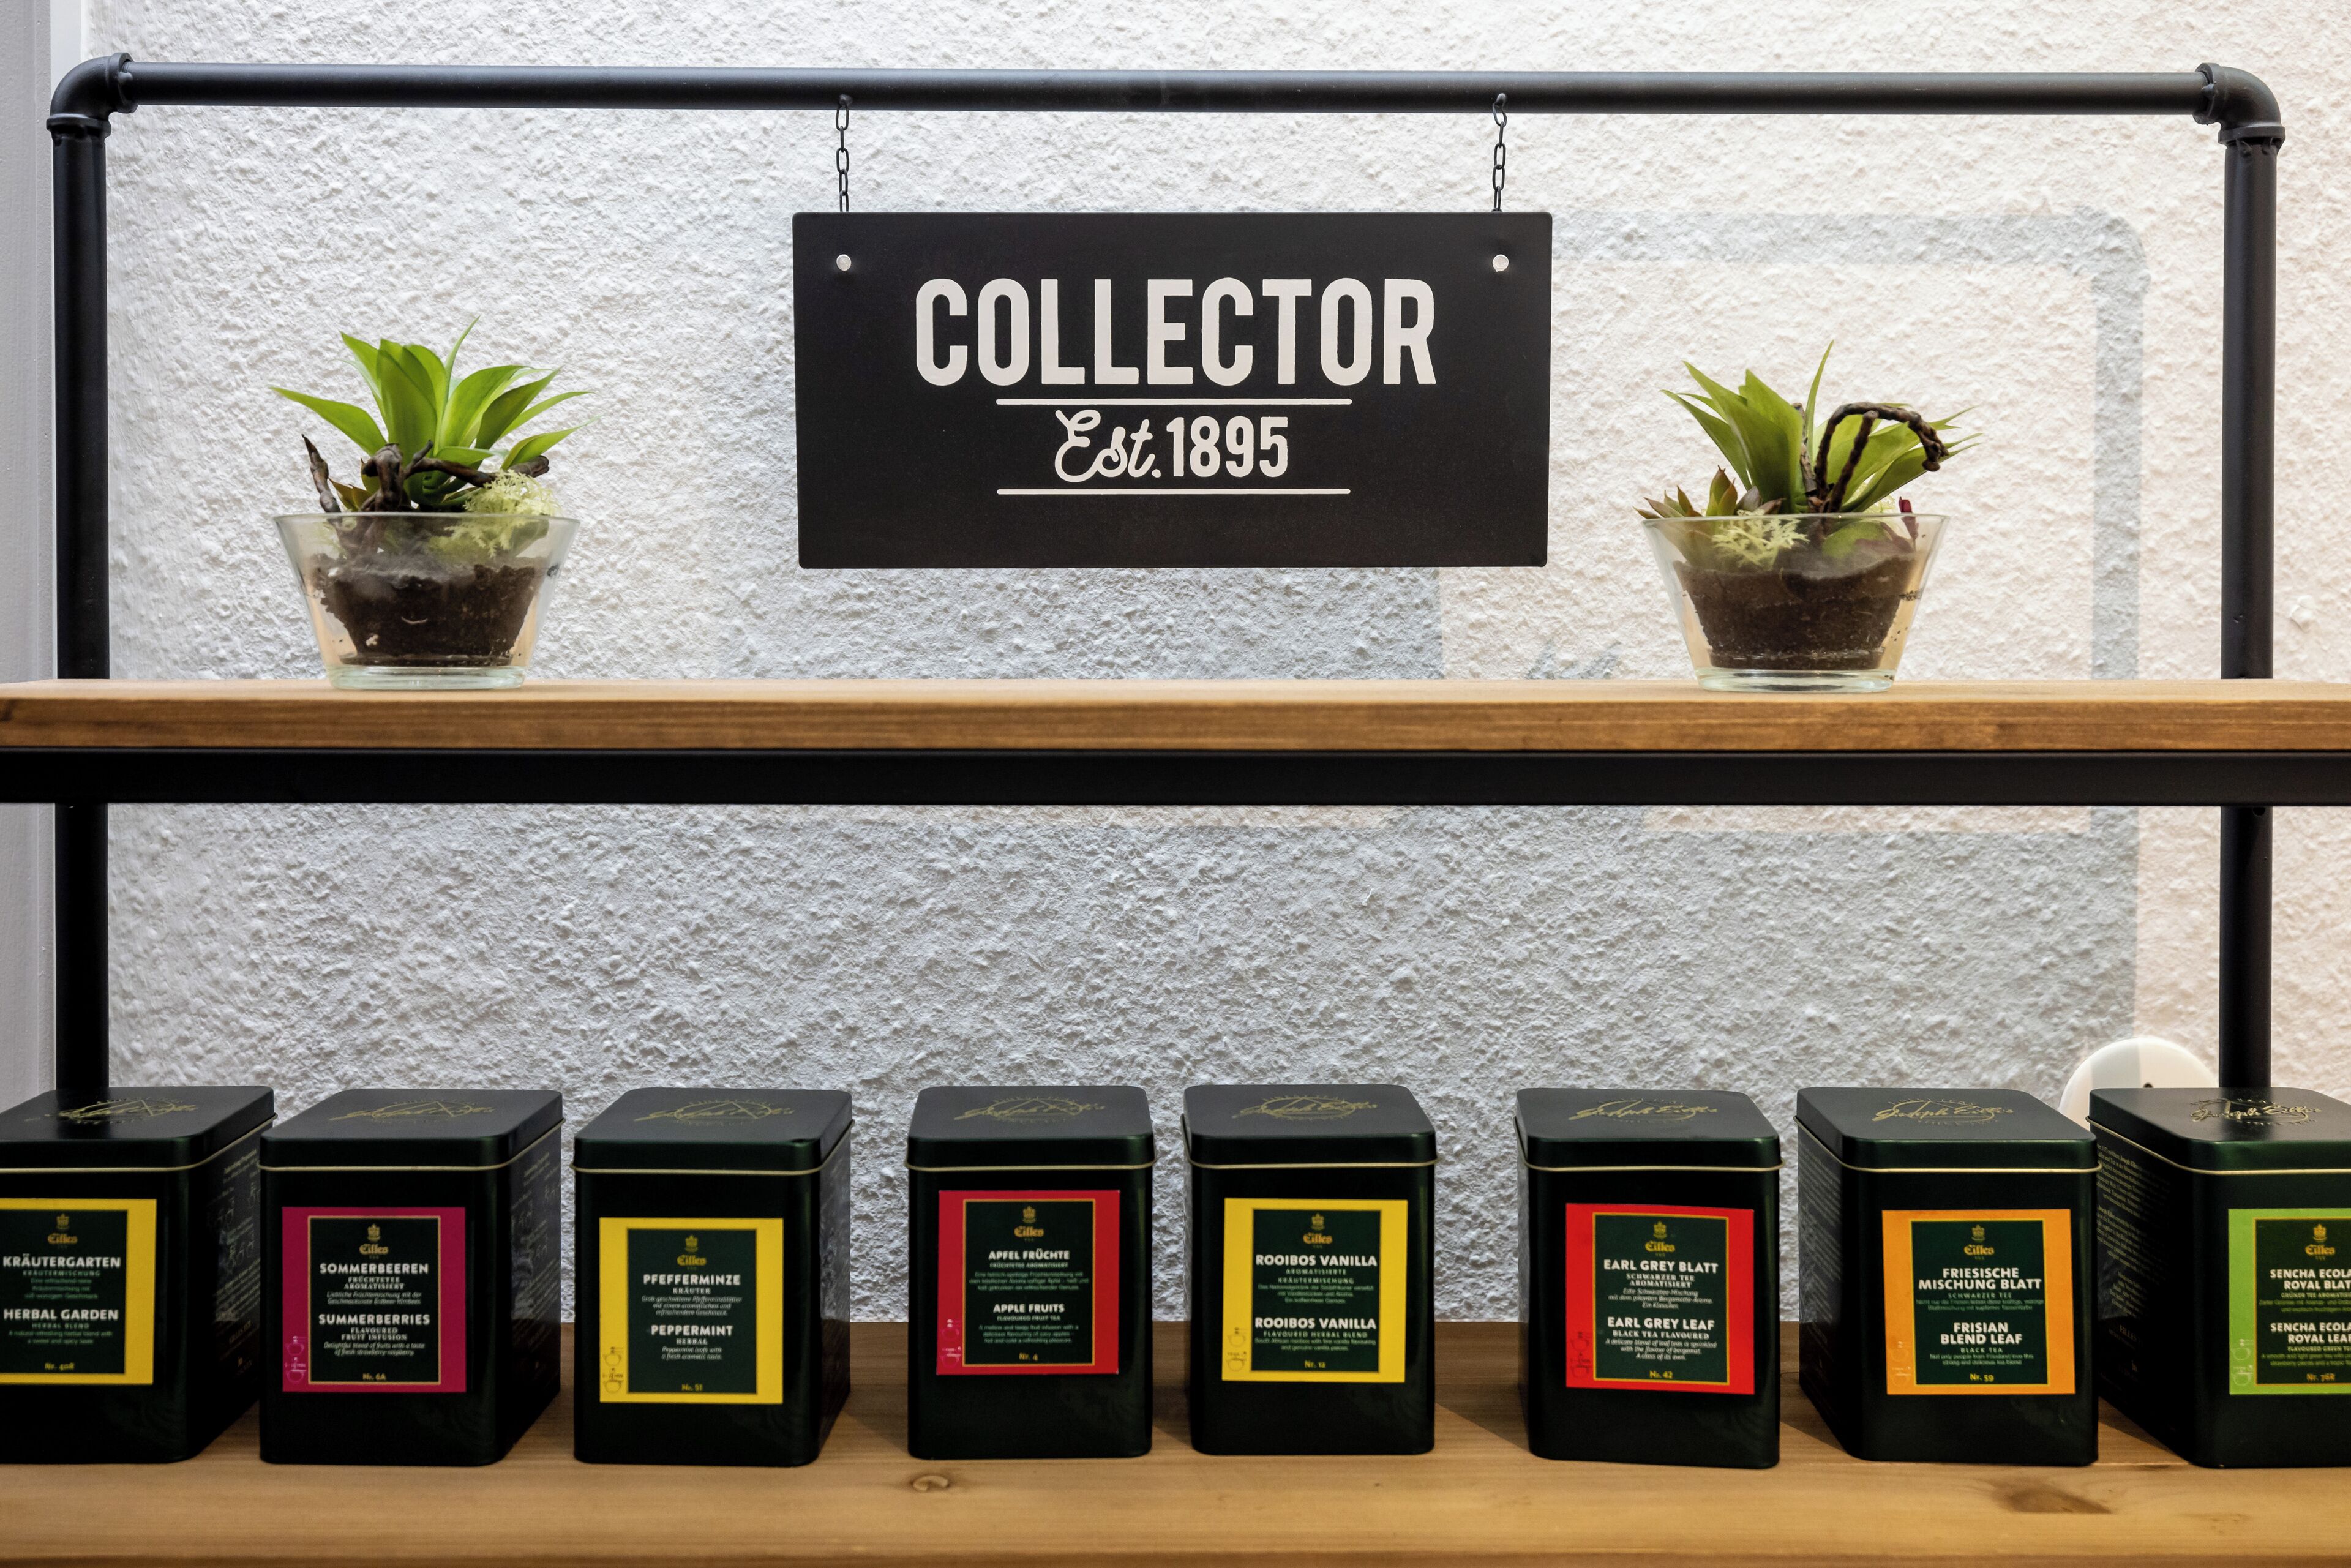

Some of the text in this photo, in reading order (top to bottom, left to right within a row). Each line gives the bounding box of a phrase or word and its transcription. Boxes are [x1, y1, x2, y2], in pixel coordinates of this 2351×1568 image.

[915, 277, 1436, 386] COLLECTOR
[1165, 416, 1289, 478] 1895
[988, 1248, 1069, 1260] APFEL FRÜCHTE
[1963, 1244, 1994, 1255] Eilles
[2305, 1244, 2335, 1255] Eilles
[3, 1253, 121, 1267] KRÄUTERGARTEN
[1256, 1254, 1377, 1266] ROOIBOS VANILLA
[320, 1263, 428, 1274] SOMMERBEEREN
[1603, 1259, 1718, 1274] EARL GREY BLATT
[1943, 1267, 2019, 1278] FRIESISCHE
[2270, 1269, 2315, 1278] SENCHA
[643, 1274, 740, 1285] PFEFFERMINZE
[1918, 1278, 2041, 1290] MISCHUNG BLATT
[2284, 1280, 2351, 1289] ROYAL BLAT
[993, 1303, 1064, 1313] APPLE FRUITS
[3, 1308, 118, 1320] HERBAL GARDEN
[318, 1313, 430, 1325] SUMMERBERRIES
[1255, 1317, 1376, 1329] ROOIBOS VANILLA
[1607, 1316, 1714, 1330] EARL GREY LEAF
[1954, 1322, 2008, 1333] FRISIAN
[2270, 1322, 2316, 1332] SENCHA
[651, 1324, 732, 1336] PEPPERMINT
[1660, 1331, 1709, 1340] FLAVOURED
[1940, 1334, 2022, 1345] BLEND LEAF
[2288, 1334, 2325, 1343] ROYAL
